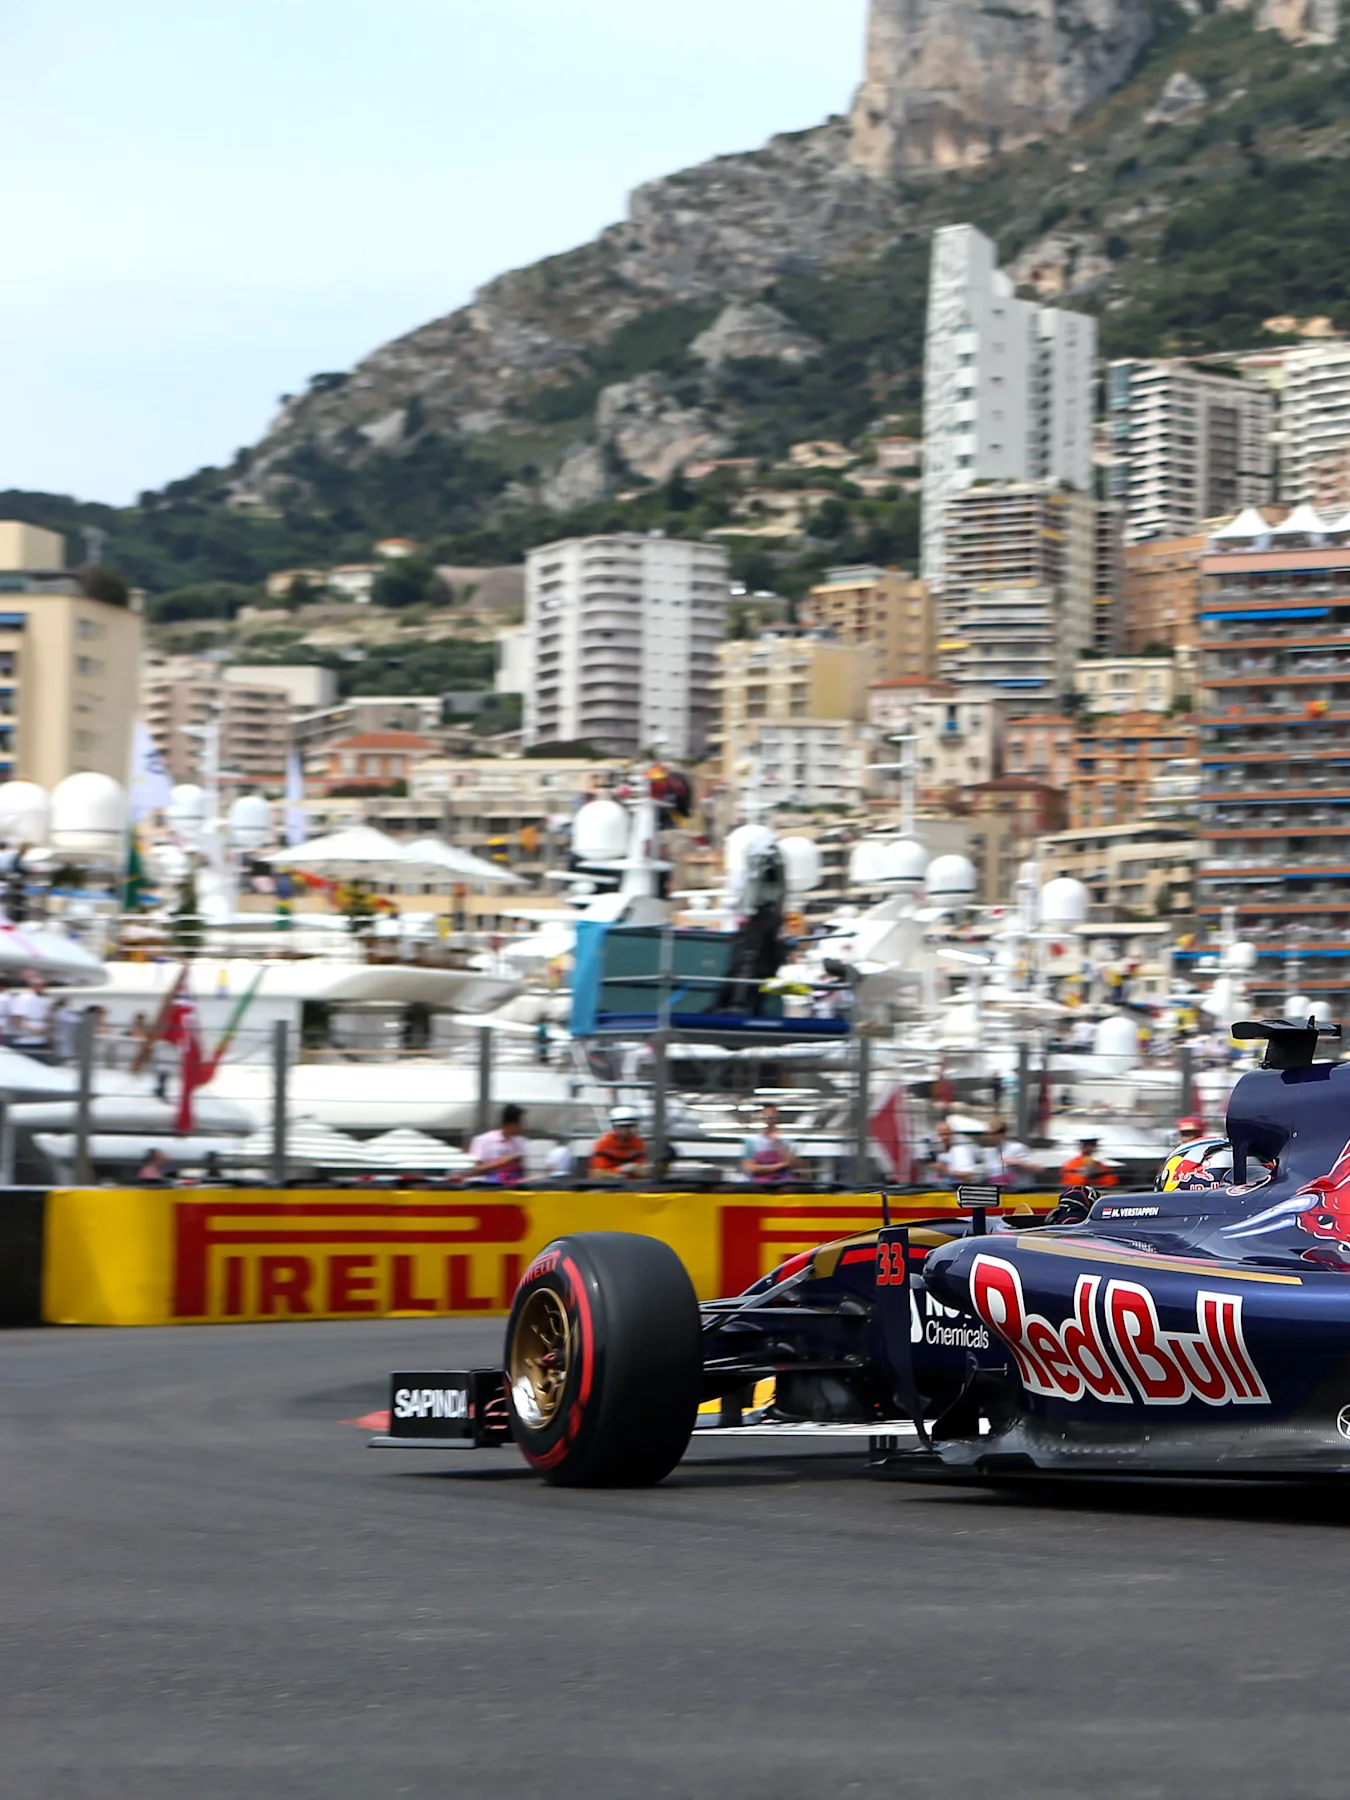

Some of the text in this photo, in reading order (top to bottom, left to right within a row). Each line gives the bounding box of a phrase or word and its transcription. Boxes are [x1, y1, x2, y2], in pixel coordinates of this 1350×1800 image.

[172, 1203, 530, 1318] PIRELLI
[876, 1242, 905, 1285] 33
[926, 1320, 989, 1349] Chemicals
[969, 1253, 1134, 1404] Red
[1104, 1278, 1272, 1406] Bull
[394, 1388, 468, 1418] SAPINDA
